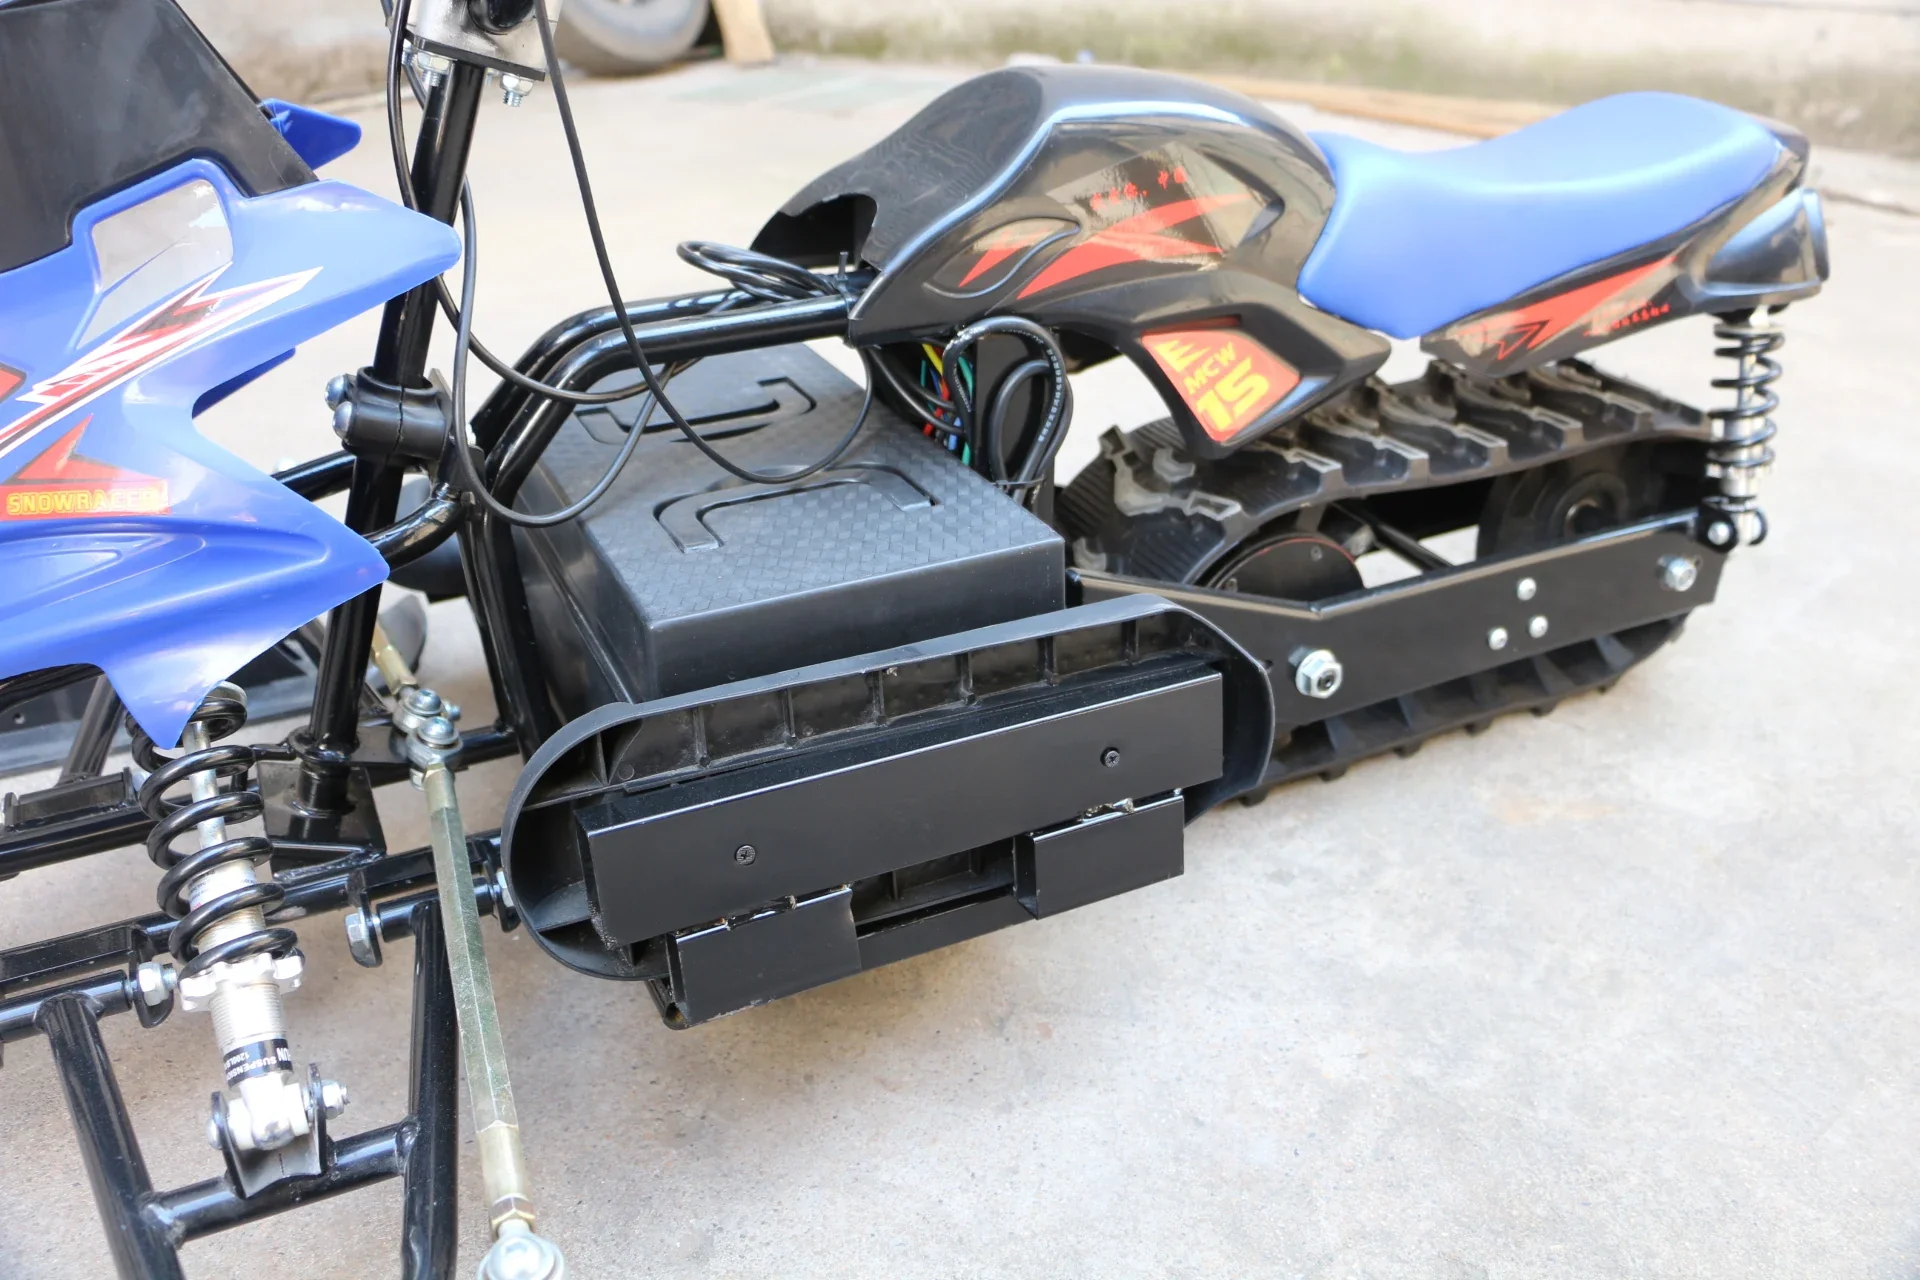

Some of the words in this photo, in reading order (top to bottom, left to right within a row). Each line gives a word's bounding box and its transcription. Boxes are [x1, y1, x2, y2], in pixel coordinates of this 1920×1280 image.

[1183, 341, 1236, 395] MCW
[1196, 356, 1270, 431] 15
[7, 488, 160, 515] SNOWRACER
[226, 1056, 277, 1079] SUSPENSIO
